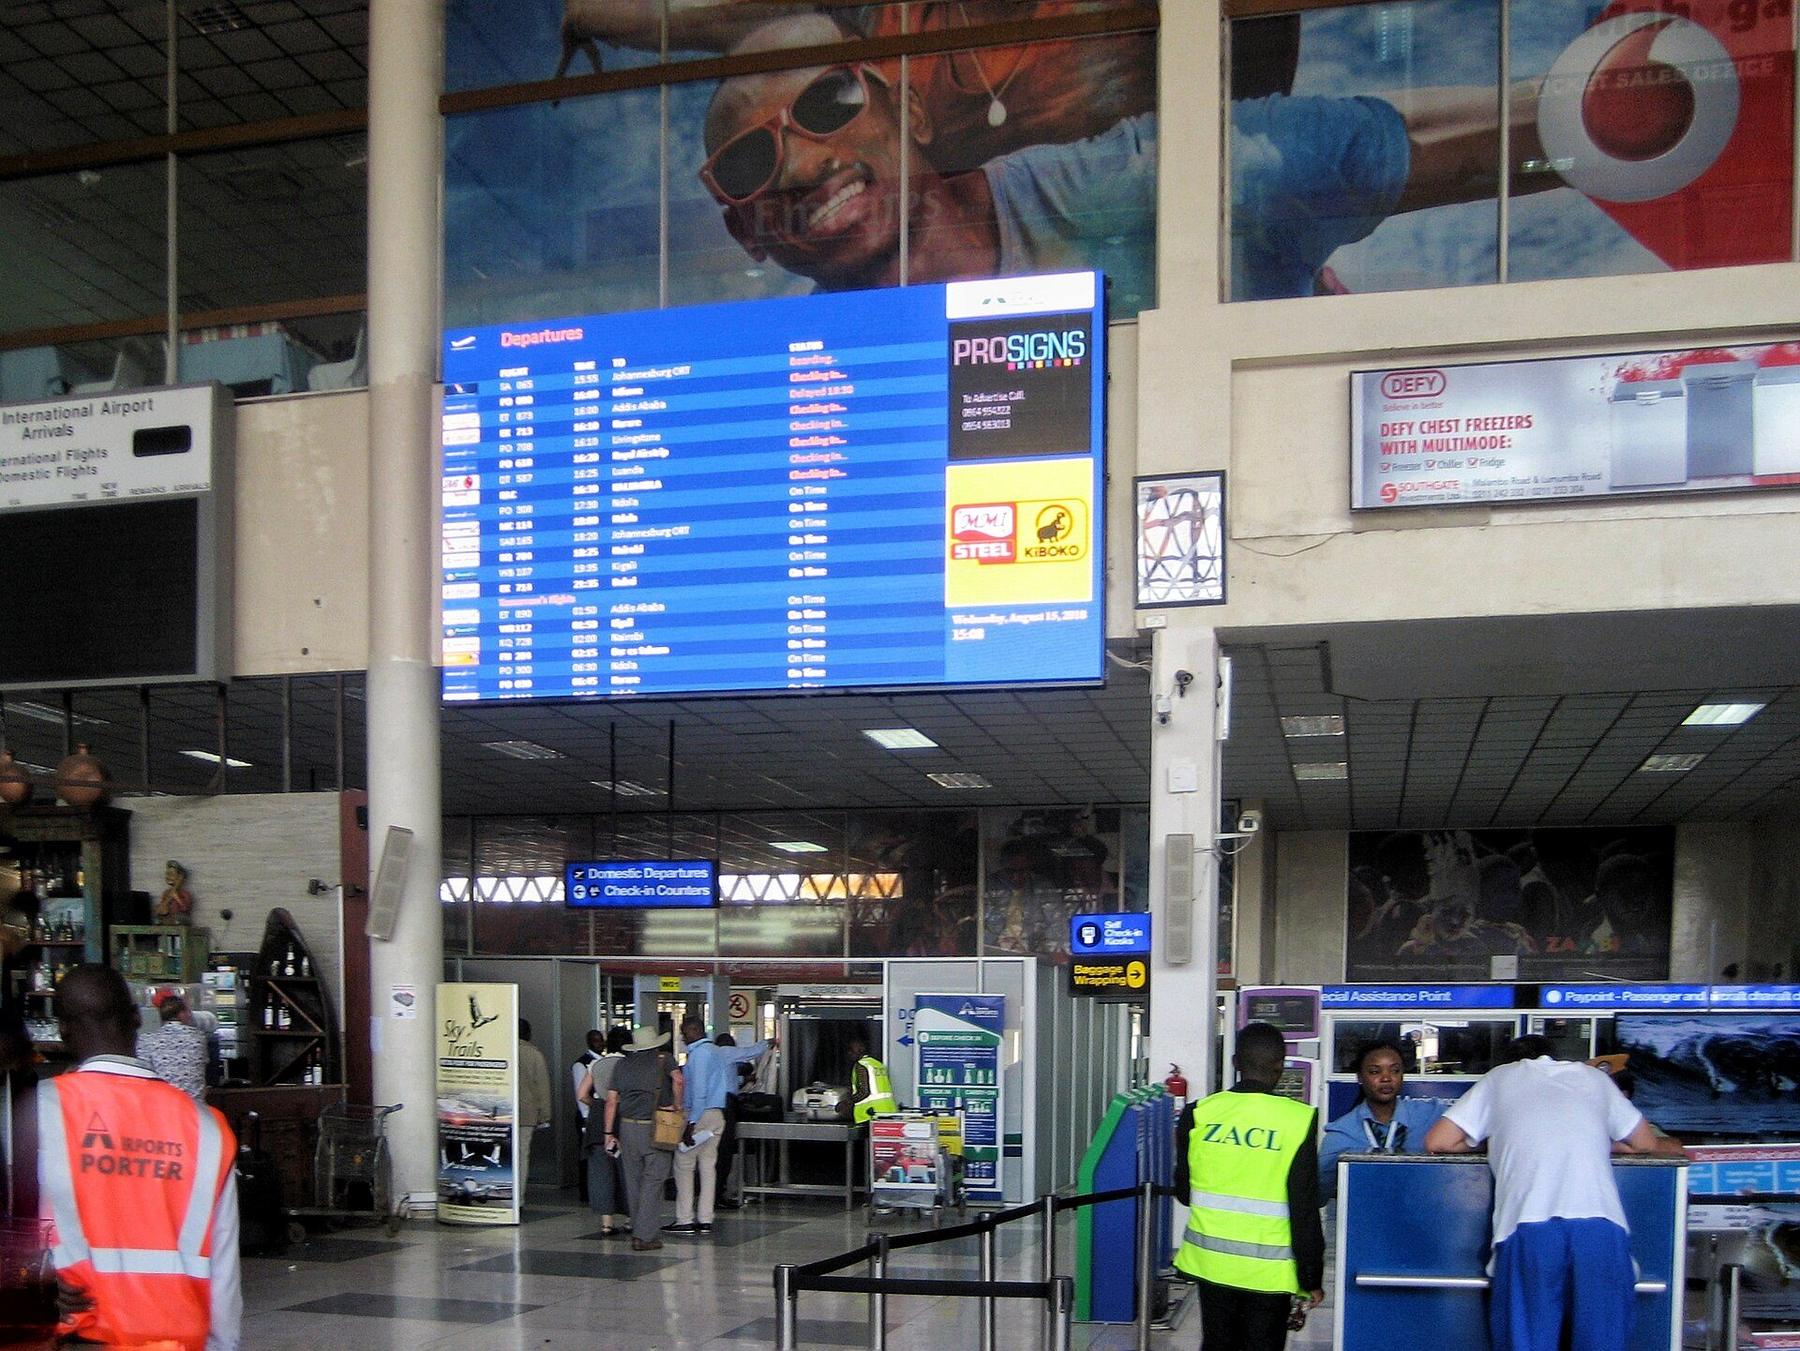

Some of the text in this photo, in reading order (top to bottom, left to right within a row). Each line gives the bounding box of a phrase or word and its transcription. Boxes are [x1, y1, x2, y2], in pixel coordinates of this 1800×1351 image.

[501, 328, 583, 348] Departures
[953, 331, 1086, 366] PROSIGNS
[1391, 376, 1437, 393] DEFY
[2, 398, 153, 425] International Airport
[22, 424, 74, 440] Arrivals
[1380, 415, 1533, 437] DEFY CHEST FREEZERS
[1380, 435, 1512, 455] WITH MULTIMODE:
[66, 448, 109, 463] Flights
[57, 465, 98, 480] Flights
[1398, 480, 1460, 493] SOUTHGATE
[955, 542, 1011, 559] STEEL
[588, 868, 709, 881] Domestic Departures
[604, 885, 710, 897] Check-in Counters
[1074, 965, 1124, 977] Baggage
[1074, 975, 1127, 987] Wrapping
[1350, 991, 1417, 1001] Assistance
[1419, 990, 1452, 1001] Point
[1565, 991, 1614, 1003] Paypoint
[1622, 991, 1682, 1004] Passenger
[1682, 991, 1706, 1001] and
[447, 1041, 484, 1057] Trails
[1203, 1123, 1282, 1151] ZACL
[81, 1153, 183, 1181] PORTER
